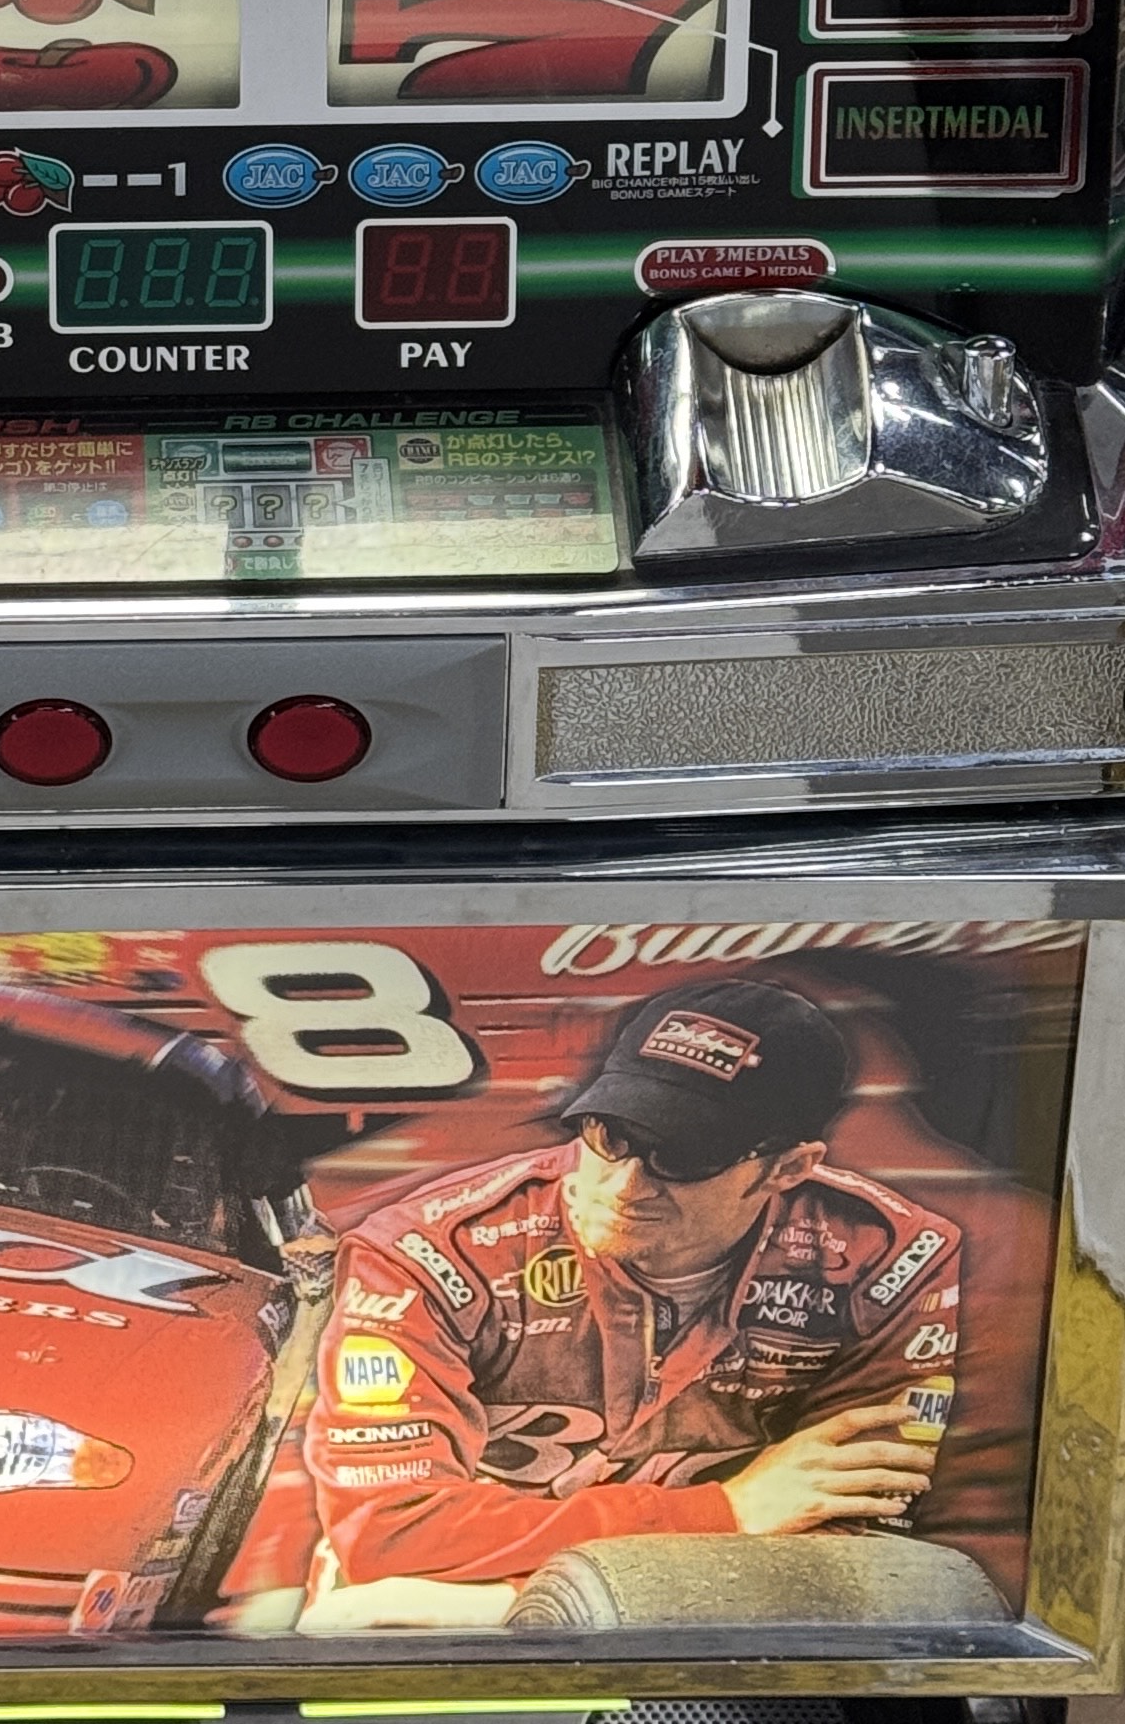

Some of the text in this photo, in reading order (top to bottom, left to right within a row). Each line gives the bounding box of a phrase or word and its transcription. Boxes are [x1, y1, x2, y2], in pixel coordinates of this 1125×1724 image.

[241, 139, 744, 189] JAC JAC JAC REPLAY
[592, 178, 612, 189] BIG
[610, 190, 654, 200] BONUS
[657, 249, 708, 263] PLAY
[649, 268, 697, 279] BONUS
[69, 345, 250, 373] COUNTER
[400, 342, 472, 368] PAY
[224, 410, 520, 430] RB CHALLENGE
[198, 940, 473, 1090] 8
[757, 1304, 810, 1328] NOIR
[344, 1356, 402, 1386] NAPA
